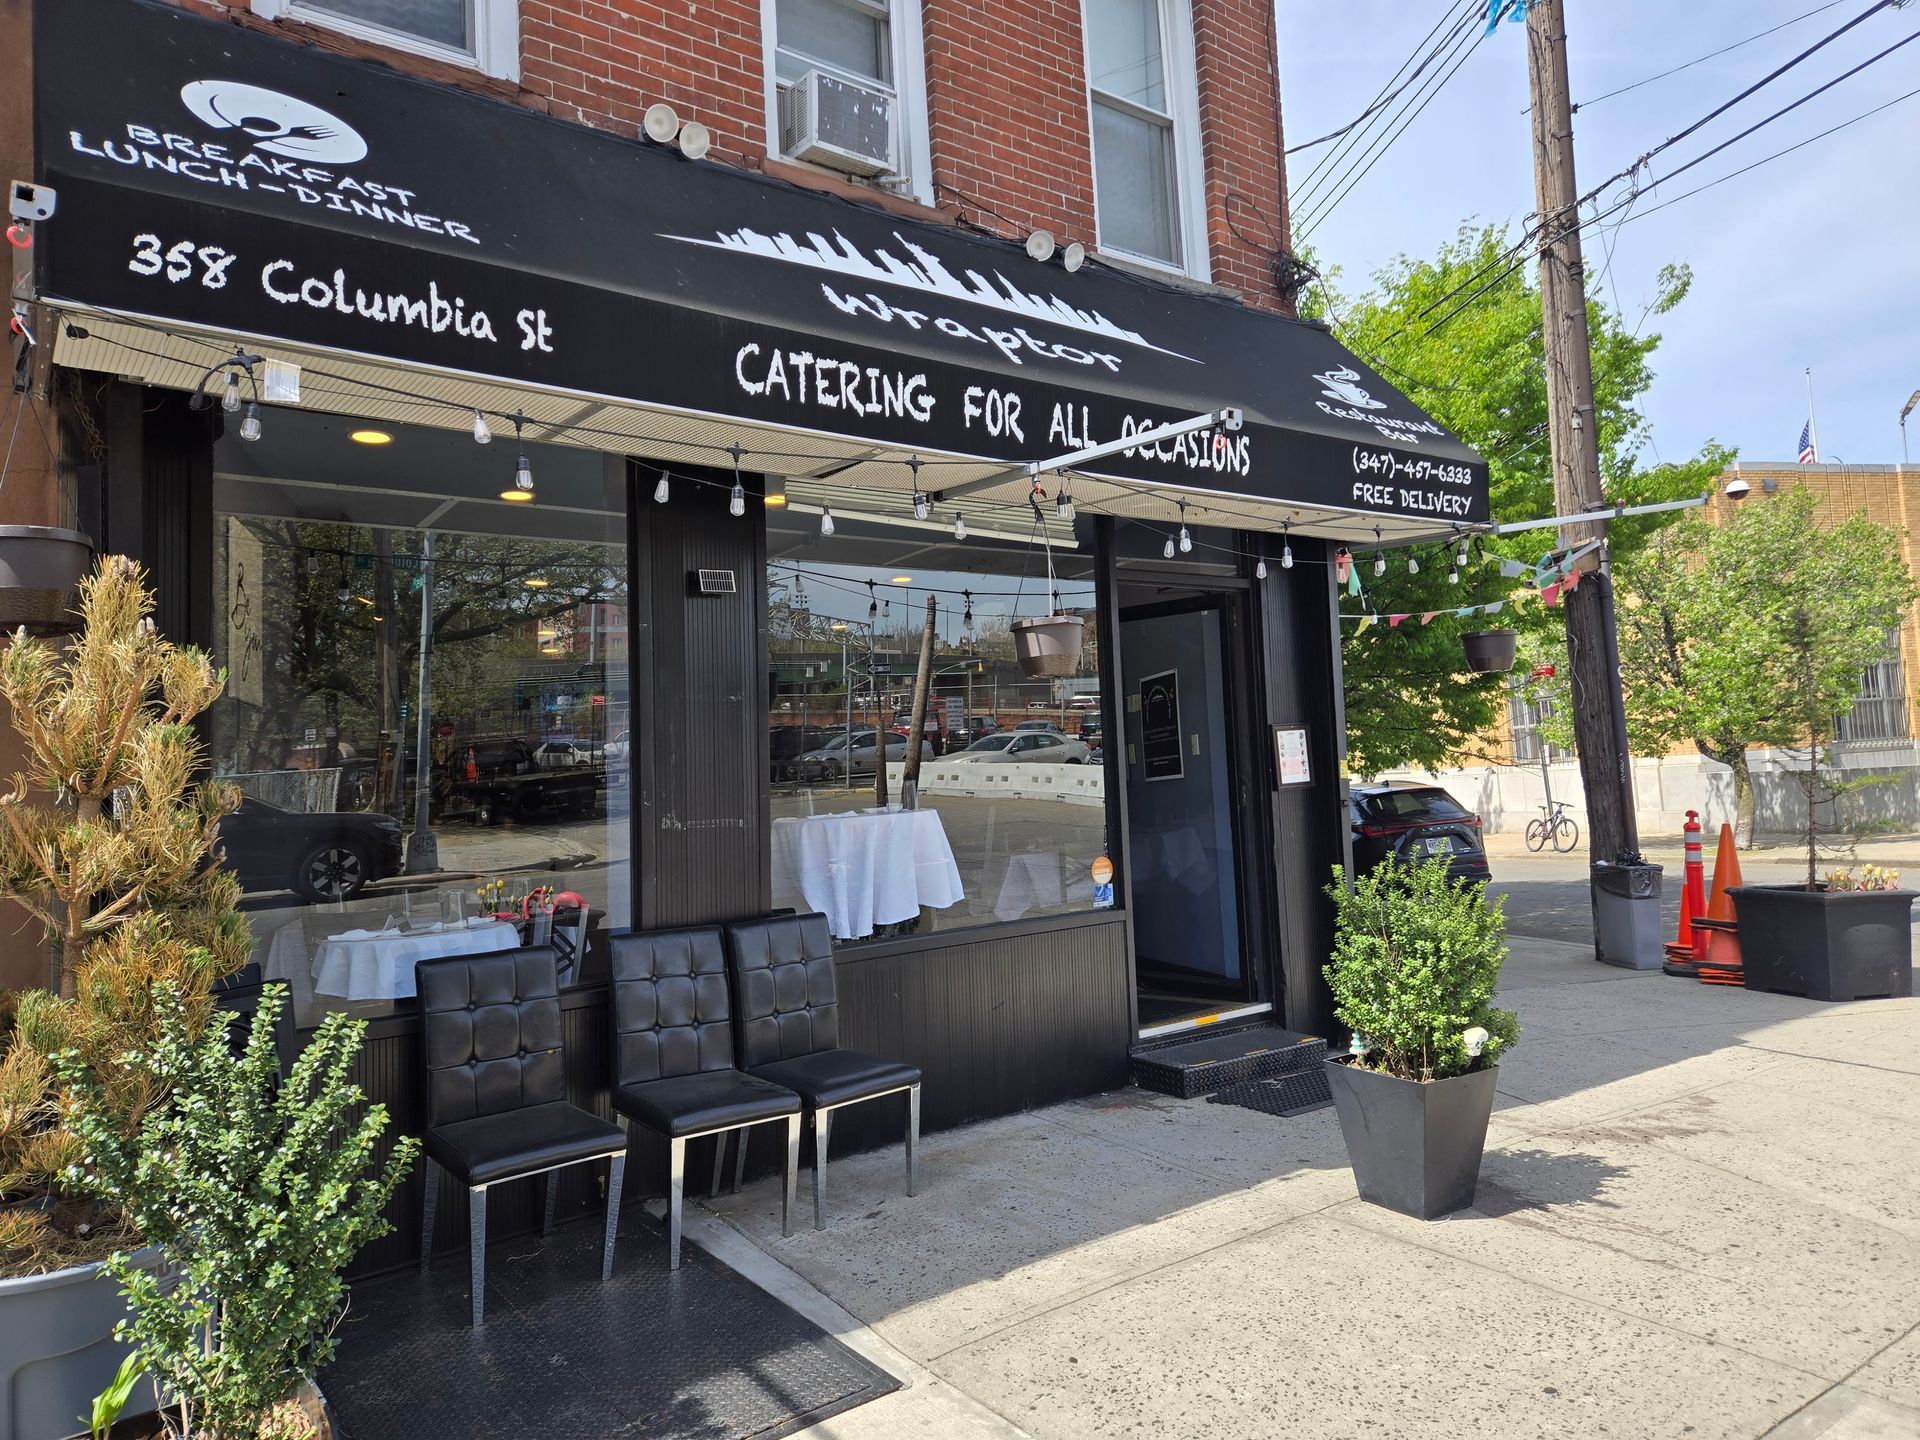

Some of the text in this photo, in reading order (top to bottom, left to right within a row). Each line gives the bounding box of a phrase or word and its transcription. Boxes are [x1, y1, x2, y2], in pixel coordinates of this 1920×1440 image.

[125, 123, 417, 208] BREAKFAST
[128, 233, 554, 353] 358 Columbia St
[735, 342, 1251, 476] CATERING FOR ALL OCCASIONS
[1315, 400, 1445, 437] Restaurant
[1375, 424, 1420, 445] Bar
[1352, 446, 1472, 486] (347)-457-6333
[1352, 482, 1473, 516] FREE DELIVERY
